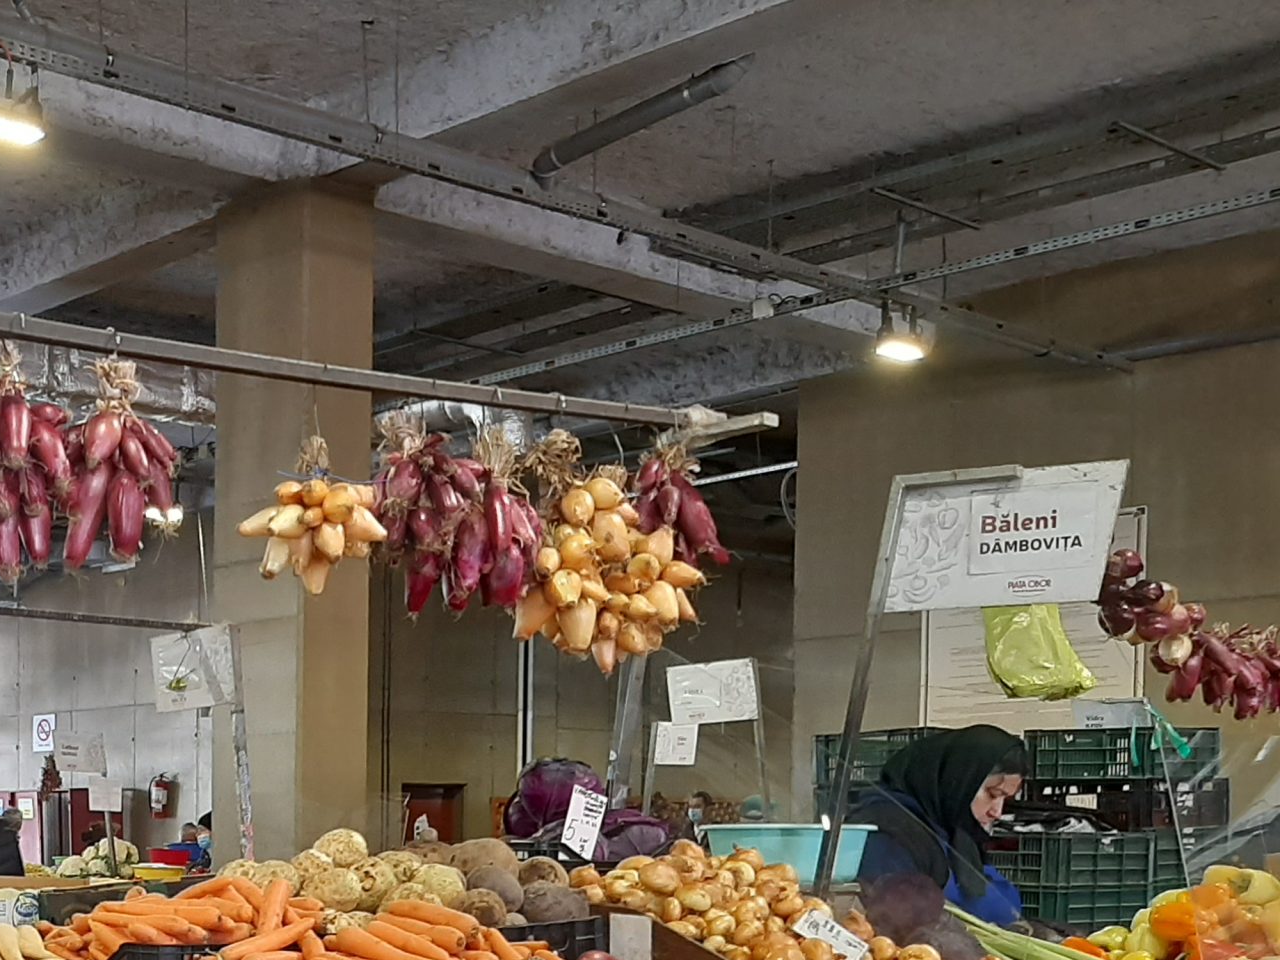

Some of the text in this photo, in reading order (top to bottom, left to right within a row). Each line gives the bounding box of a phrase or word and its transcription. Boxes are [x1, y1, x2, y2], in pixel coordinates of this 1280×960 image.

[980, 509, 1058, 535] Băleni
[979, 534, 1083, 556] DÂMBOVIȚA
[563, 818, 579, 841] 5
